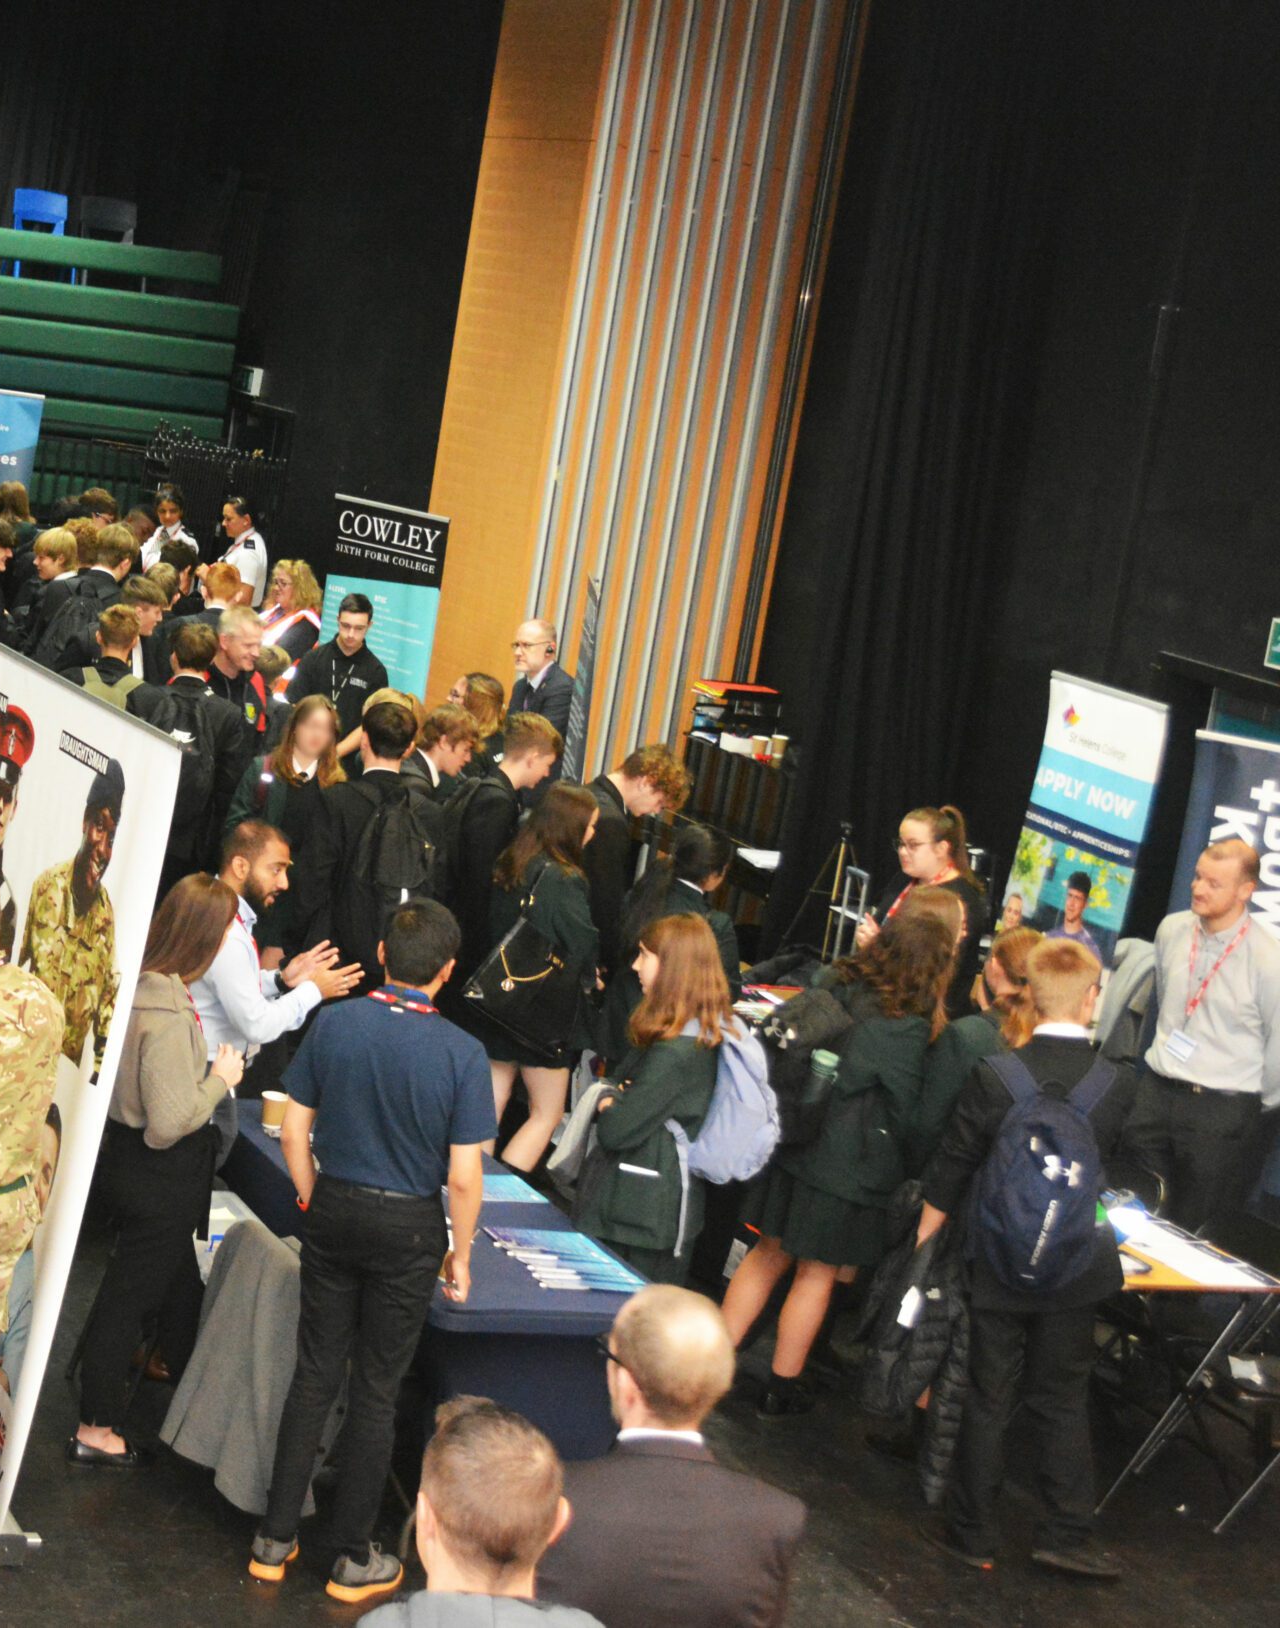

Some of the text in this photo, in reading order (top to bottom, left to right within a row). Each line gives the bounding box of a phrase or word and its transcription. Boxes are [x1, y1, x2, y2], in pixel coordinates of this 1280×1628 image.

[339, 510, 441, 553] COWLEY
[335, 543, 435, 574] SIXTH FORM COLLEGE
[60, 732, 109, 775] DRAUGHTSMAN
[1036, 766, 1137, 820] APPLY NOW
[1072, 830, 1131, 858] APPRENTICESHIPS
